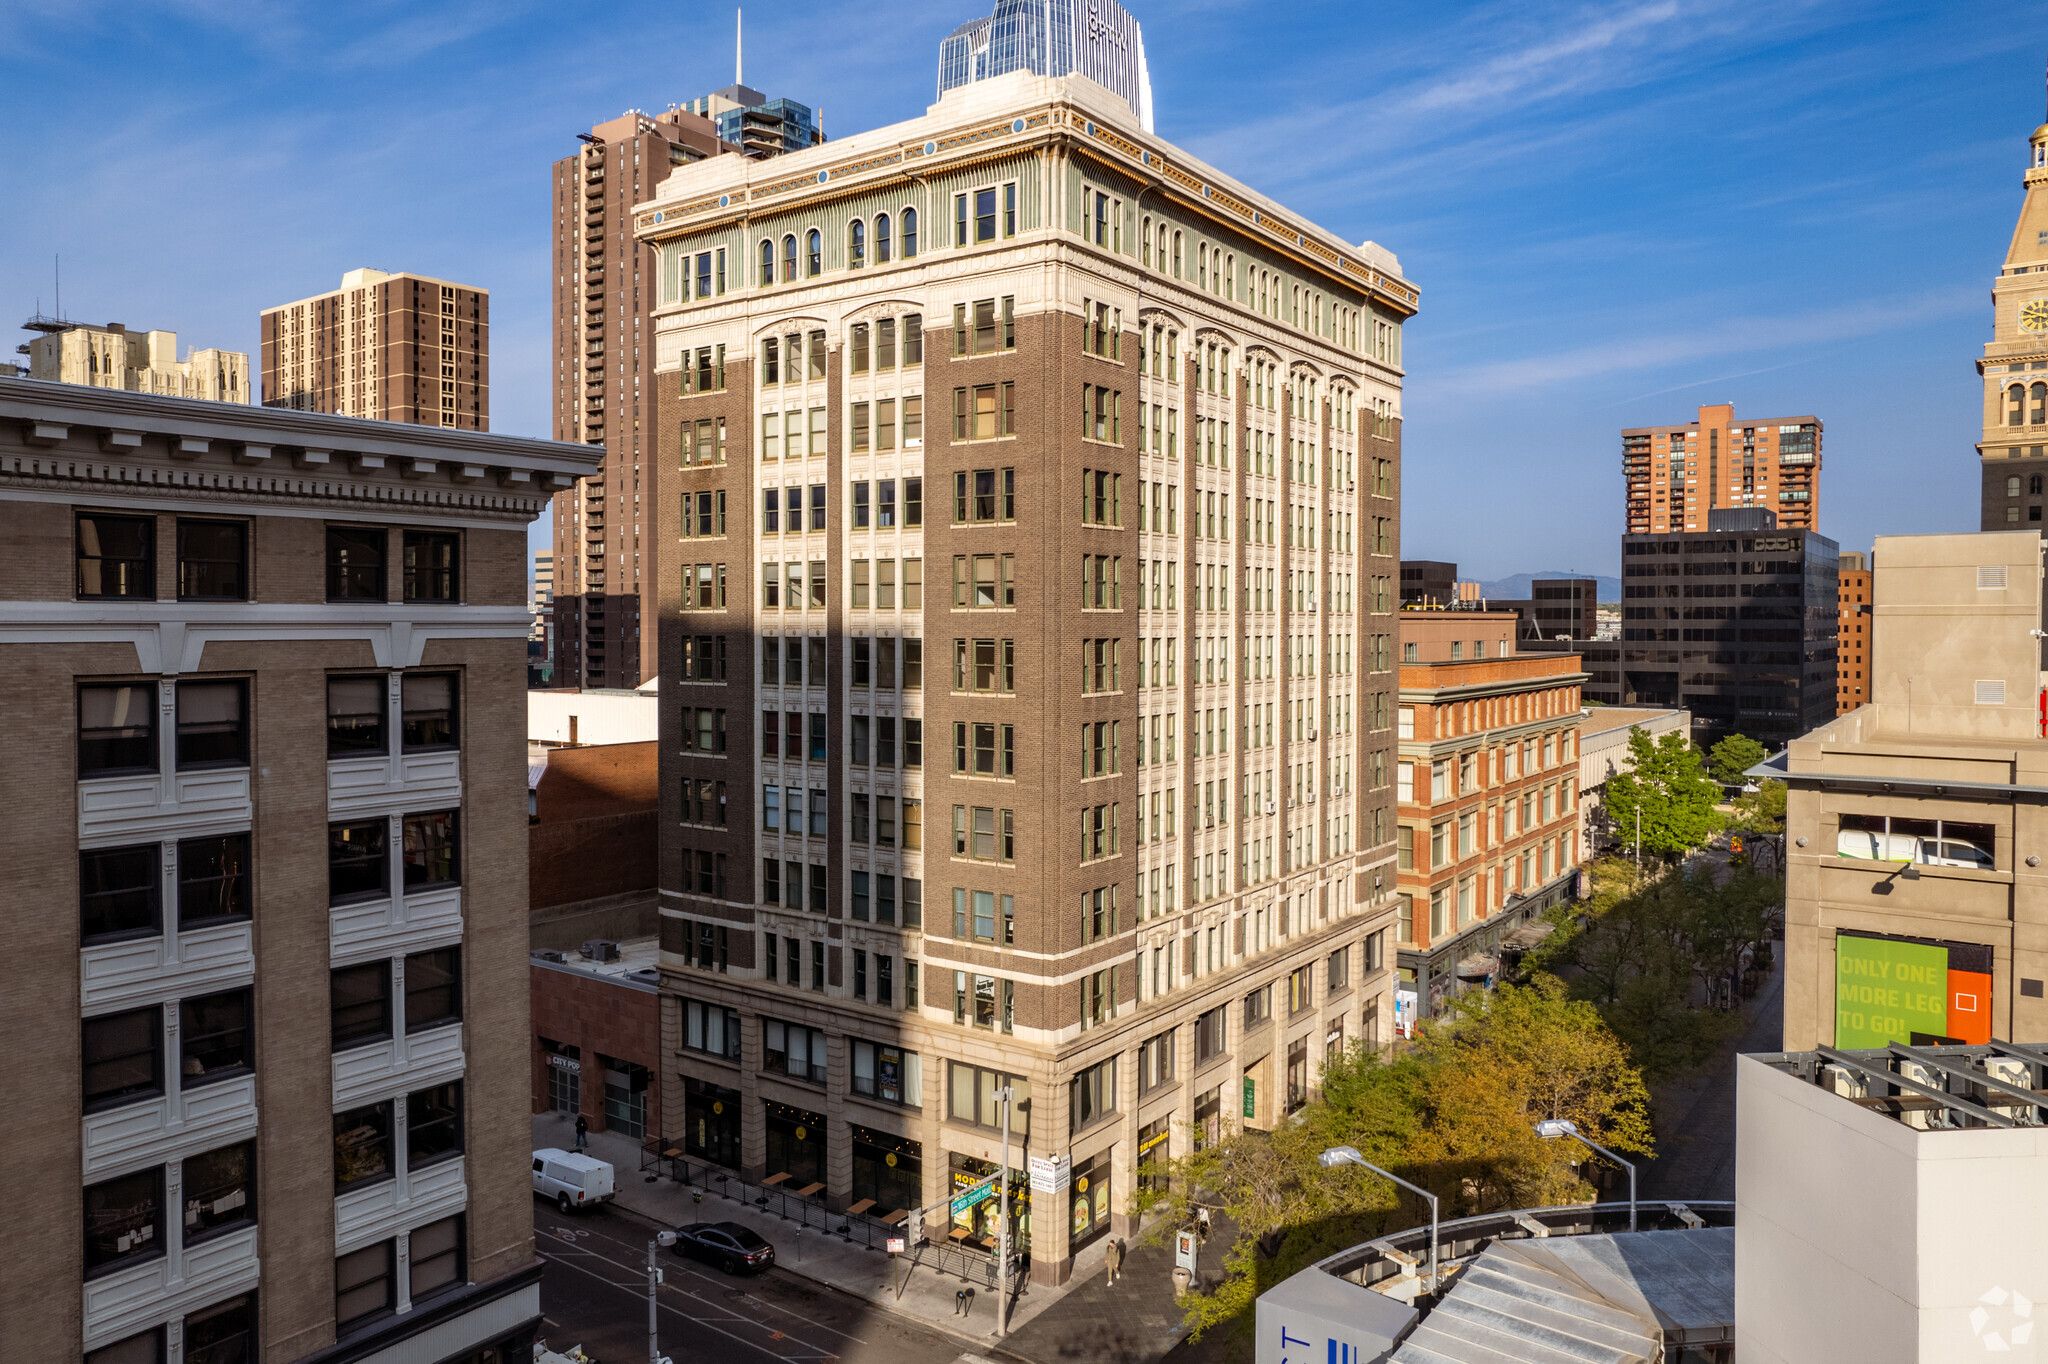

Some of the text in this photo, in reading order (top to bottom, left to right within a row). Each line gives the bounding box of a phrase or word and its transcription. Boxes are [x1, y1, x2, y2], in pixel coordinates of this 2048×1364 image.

[1840, 956, 1937, 986] ONLY ONE
[1840, 983, 1942, 1015] MORE LEG
[1840, 1010, 1905, 1037] TO GO!
[552, 1056, 567, 1067] CITY
[957, 1199, 968, 1211] 16th
[968, 1190, 982, 1205] Street
[982, 1184, 992, 1198] Mall
